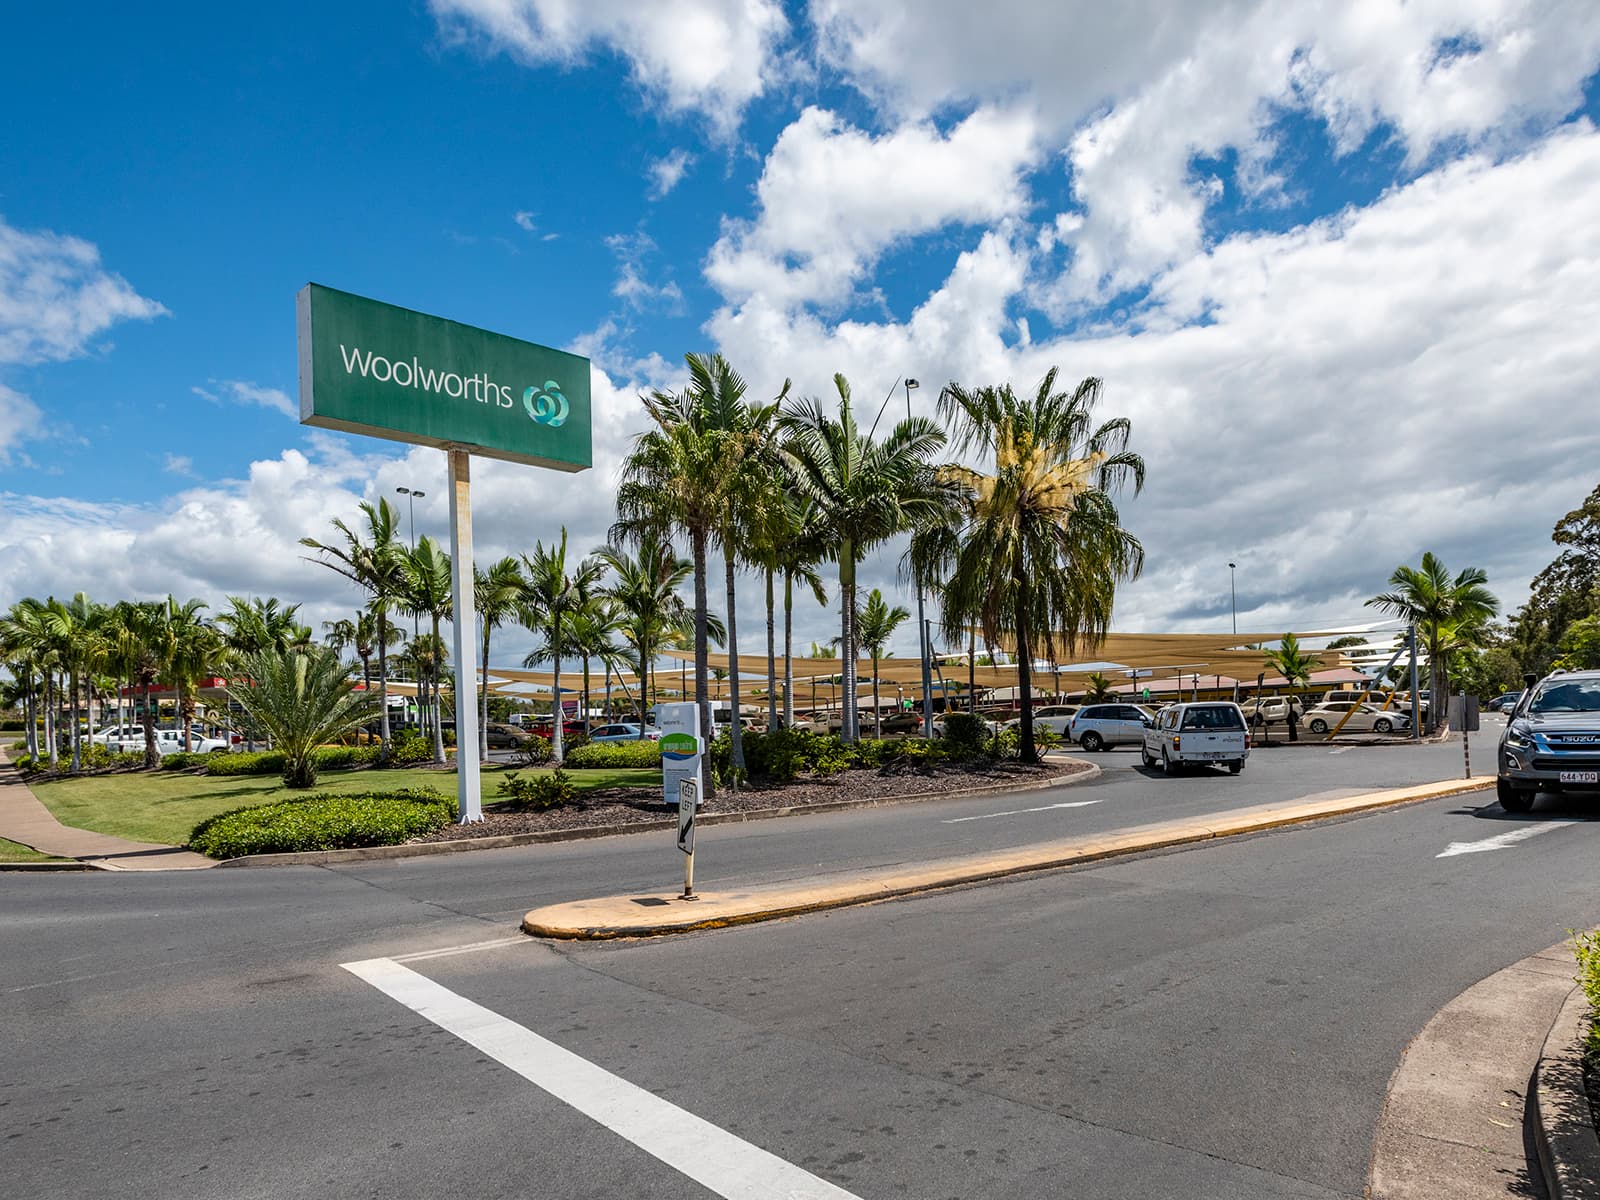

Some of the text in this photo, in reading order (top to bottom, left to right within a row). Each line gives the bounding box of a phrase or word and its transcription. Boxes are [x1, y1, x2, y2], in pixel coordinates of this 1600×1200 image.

[340, 344, 513, 408] Woolworths
[1562, 735, 1595, 744] ISUZU
[682, 783, 694, 798] KEEP
[682, 799, 692, 812] LEFT
